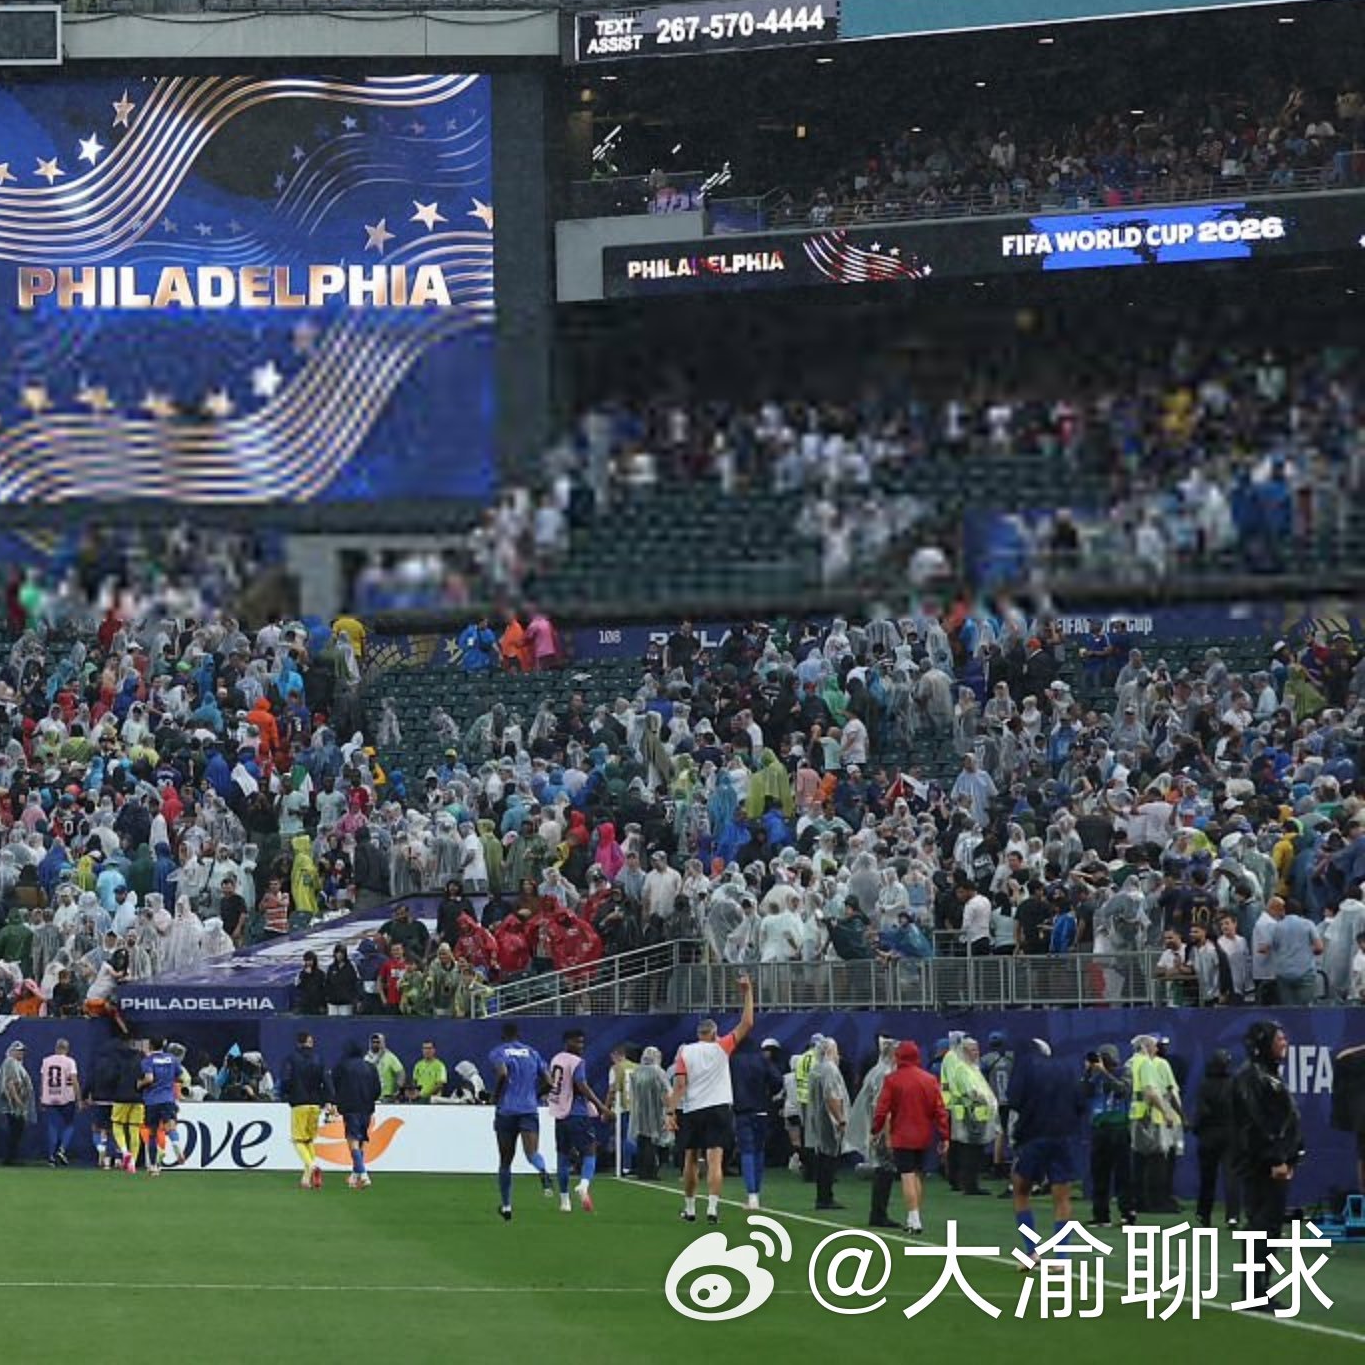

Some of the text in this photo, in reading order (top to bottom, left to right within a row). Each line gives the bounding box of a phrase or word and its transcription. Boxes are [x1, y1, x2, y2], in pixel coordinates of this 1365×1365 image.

[594, 18, 636, 36] TEXT
[656, 5, 825, 44] 267-570-4444
[587, 35, 642, 54] ASSIST
[1001, 216, 1284, 256] FIFA WORLD CUP 2026
[17, 264, 453, 308] PHILADELPHIA
[121, 998, 275, 1010] PHILADELPHIA
[1278, 1045, 1335, 1094] IFA
[156, 1119, 273, 1169] ove
